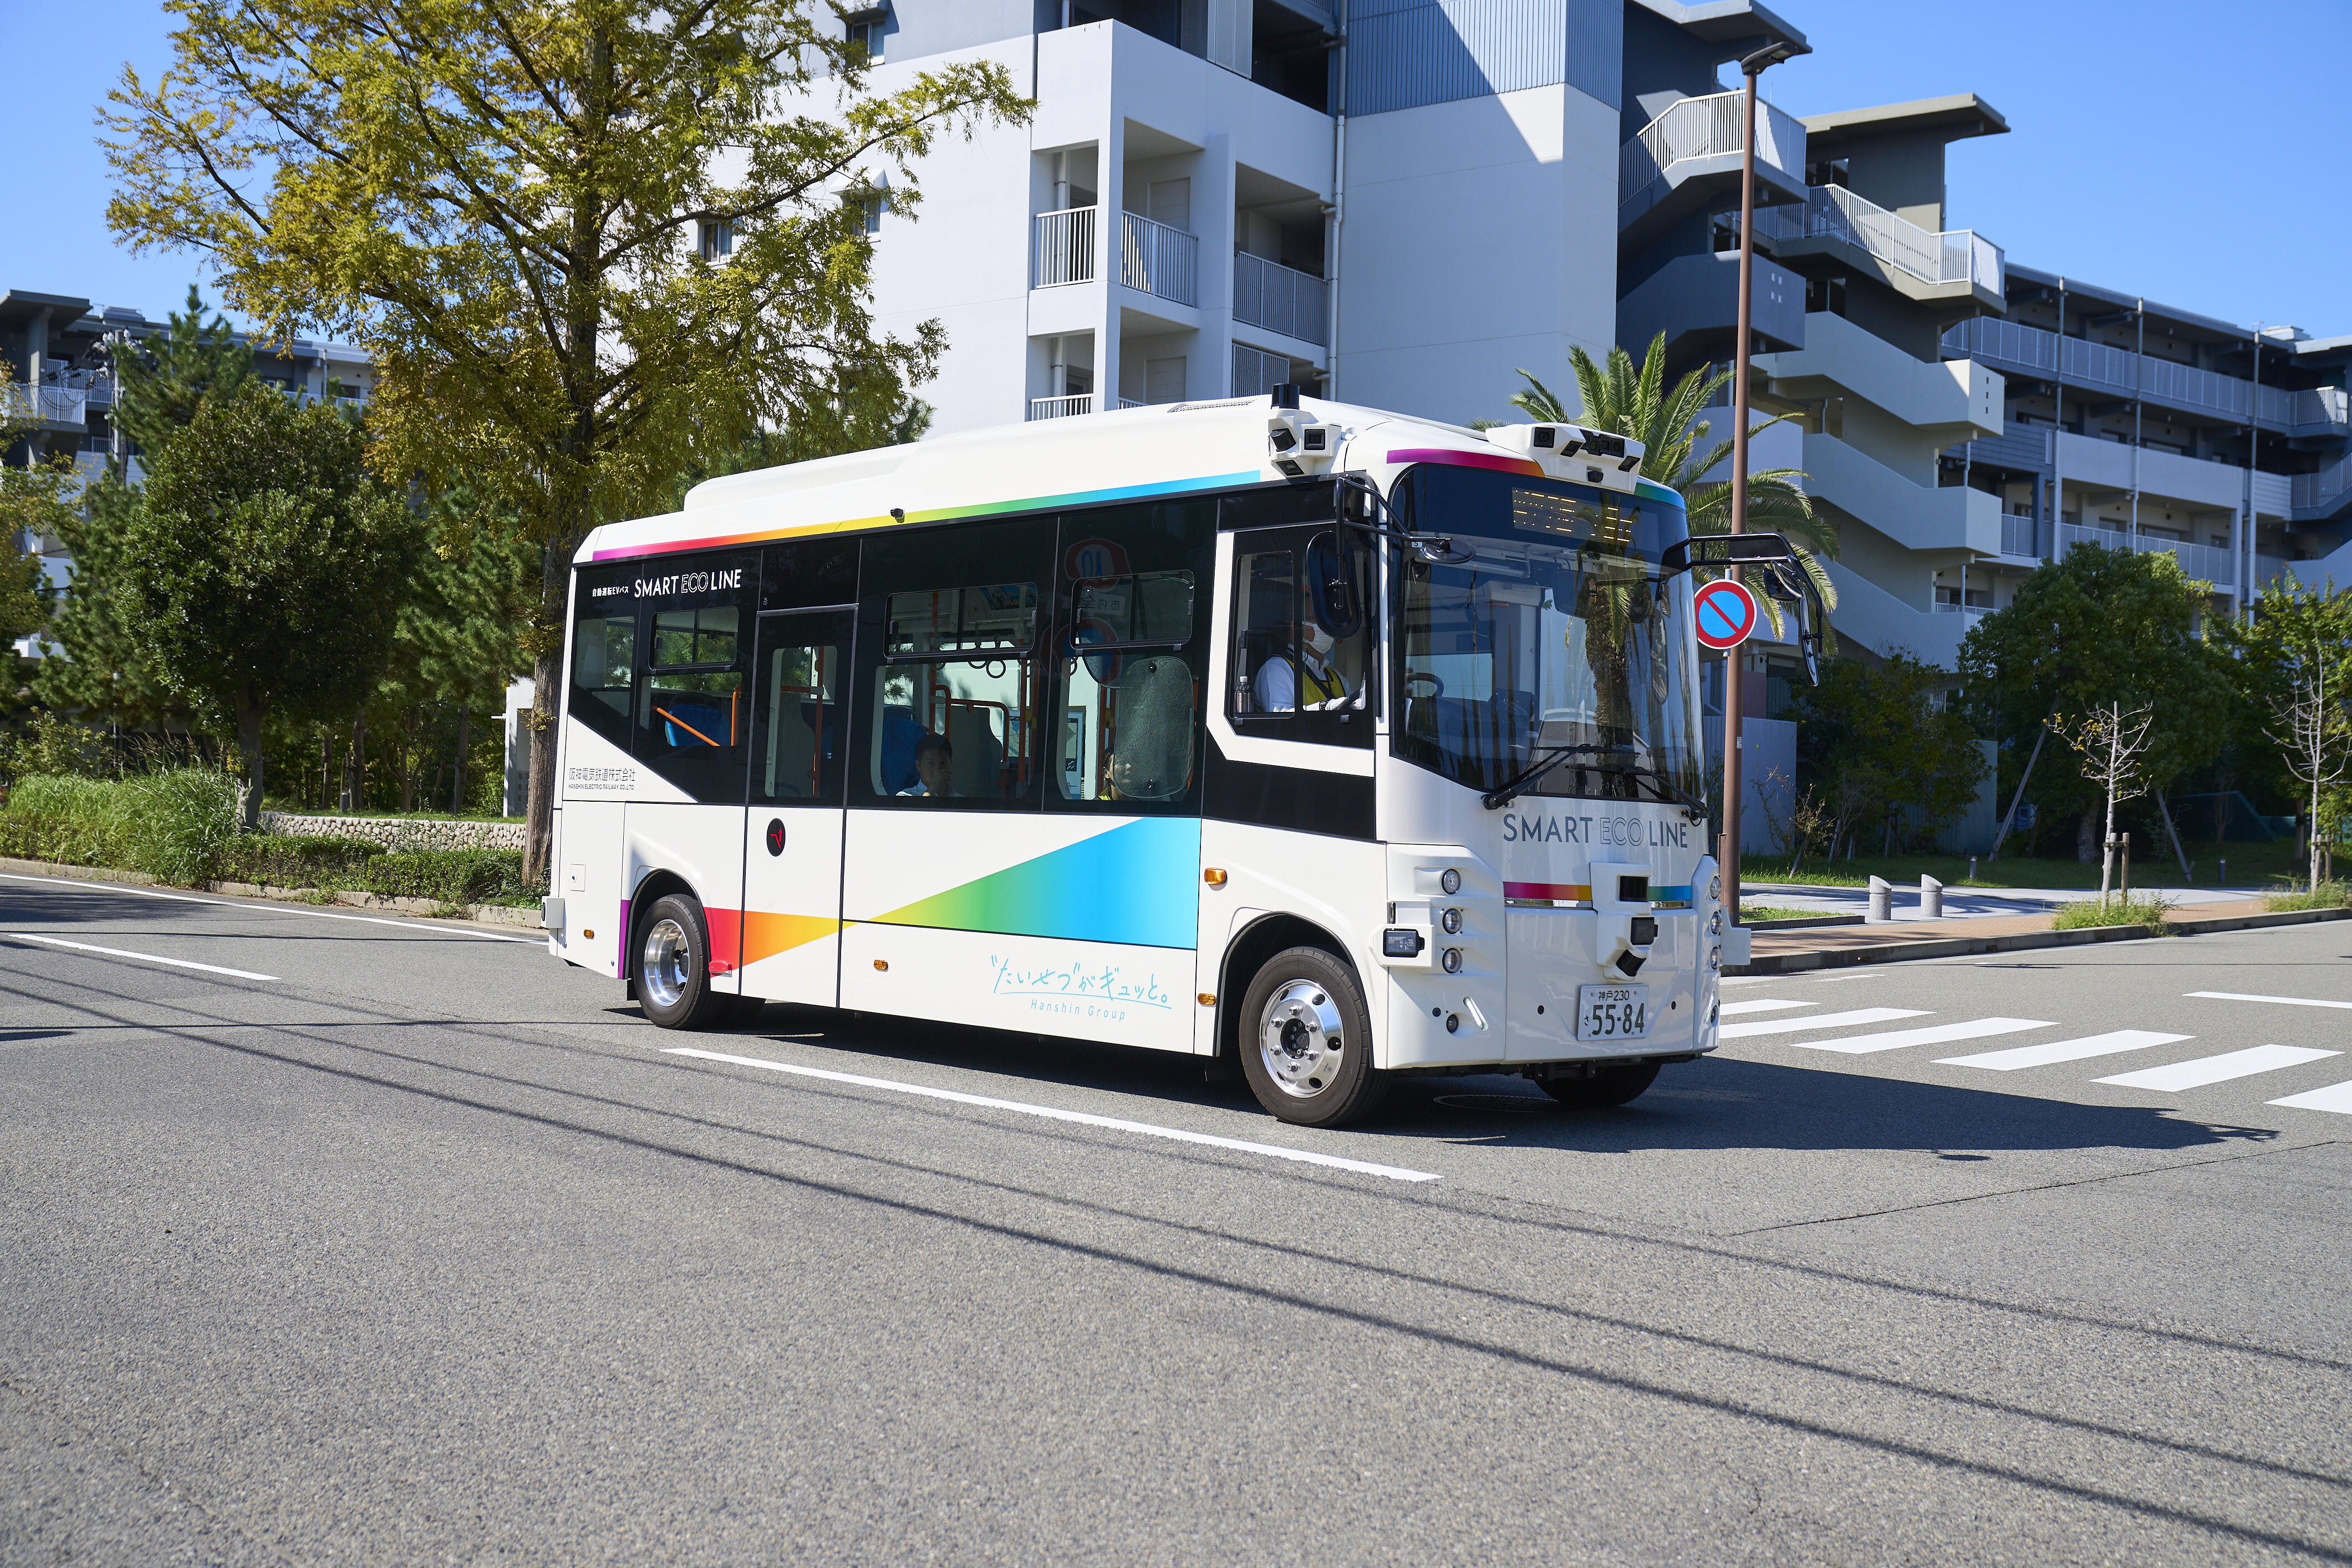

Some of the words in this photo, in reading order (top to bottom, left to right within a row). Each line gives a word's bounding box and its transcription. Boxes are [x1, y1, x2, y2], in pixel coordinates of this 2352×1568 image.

[592, 586, 629, 597] 自動運転EVバス
[634, 576, 679, 598] SMART
[681, 572, 709, 593] ECO
[711, 569, 742, 590] LINE
[569, 768, 635, 781] 阪神電気鉄道株式会社
[1504, 813, 1593, 844] SMART
[1600, 817, 1644, 846] ECO
[1650, 821, 1688, 848] LINE
[1598, 990, 1630, 1001] 神戸230
[1031, 999, 1080, 1015] Hanshin
[1088, 1006, 1126, 1022] Group
[1584, 1015, 1589, 1026] さ
[1592, 1003, 1644, 1035] 55-84
